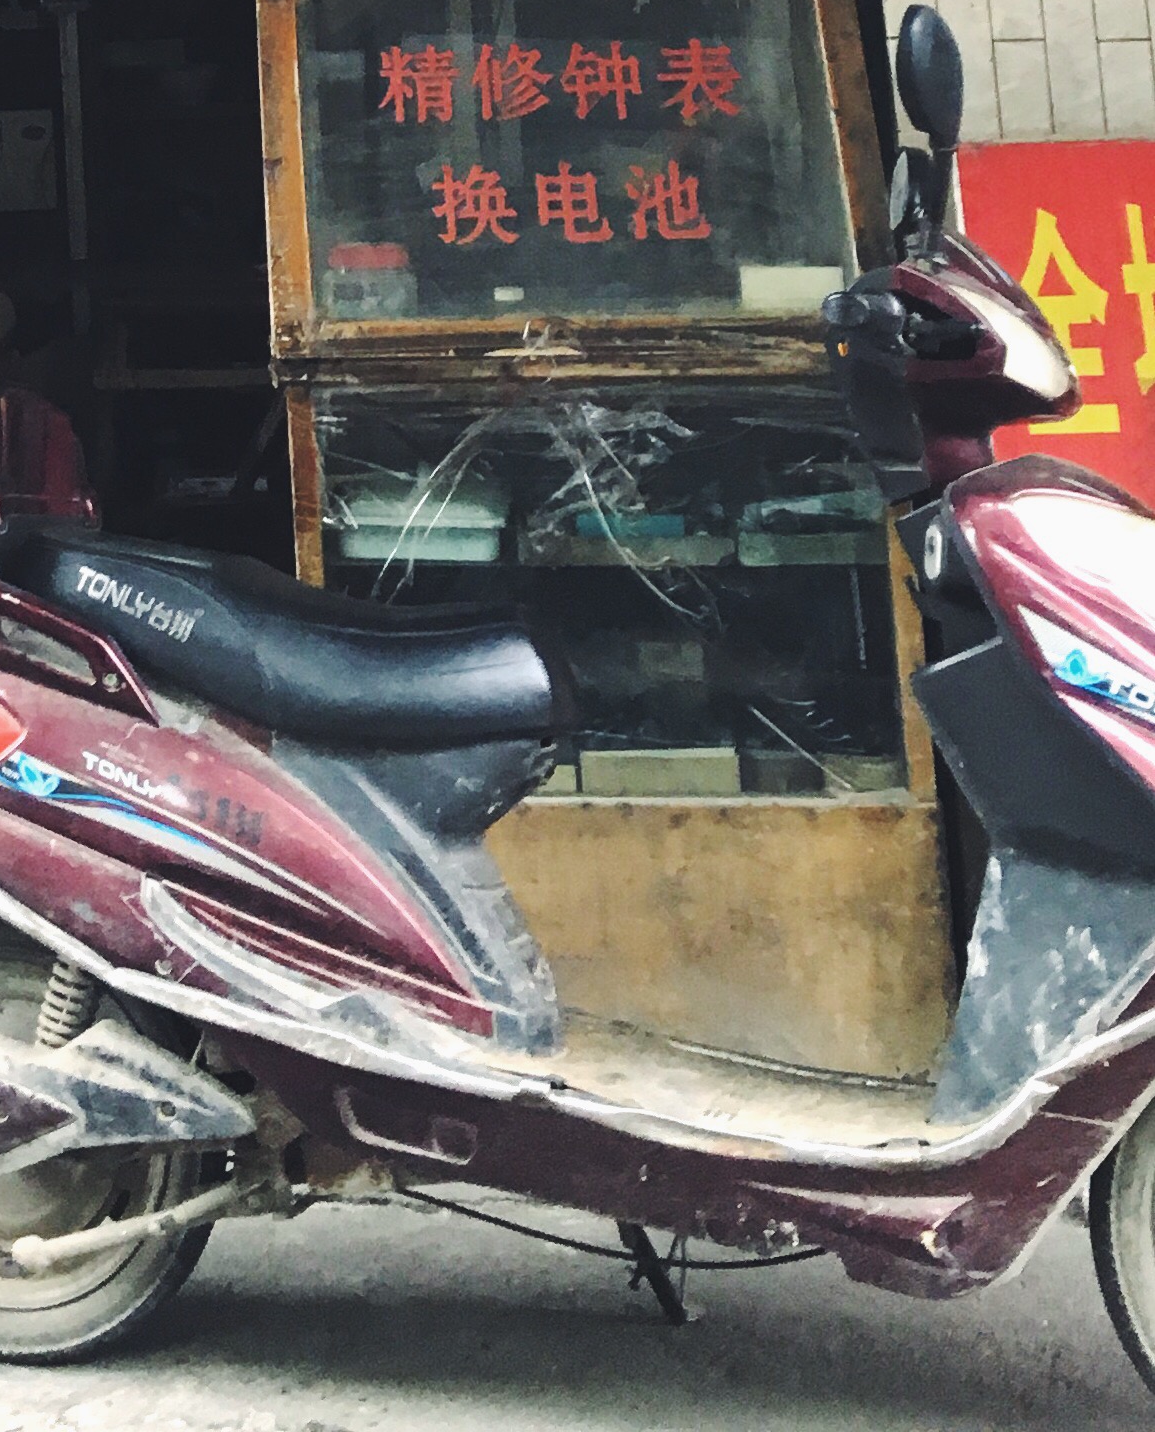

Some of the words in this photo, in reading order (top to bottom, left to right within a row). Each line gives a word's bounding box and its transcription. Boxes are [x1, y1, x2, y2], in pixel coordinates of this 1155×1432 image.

[378, 38, 742, 124] 精修钟表
[431, 160, 712, 246] 换电池
